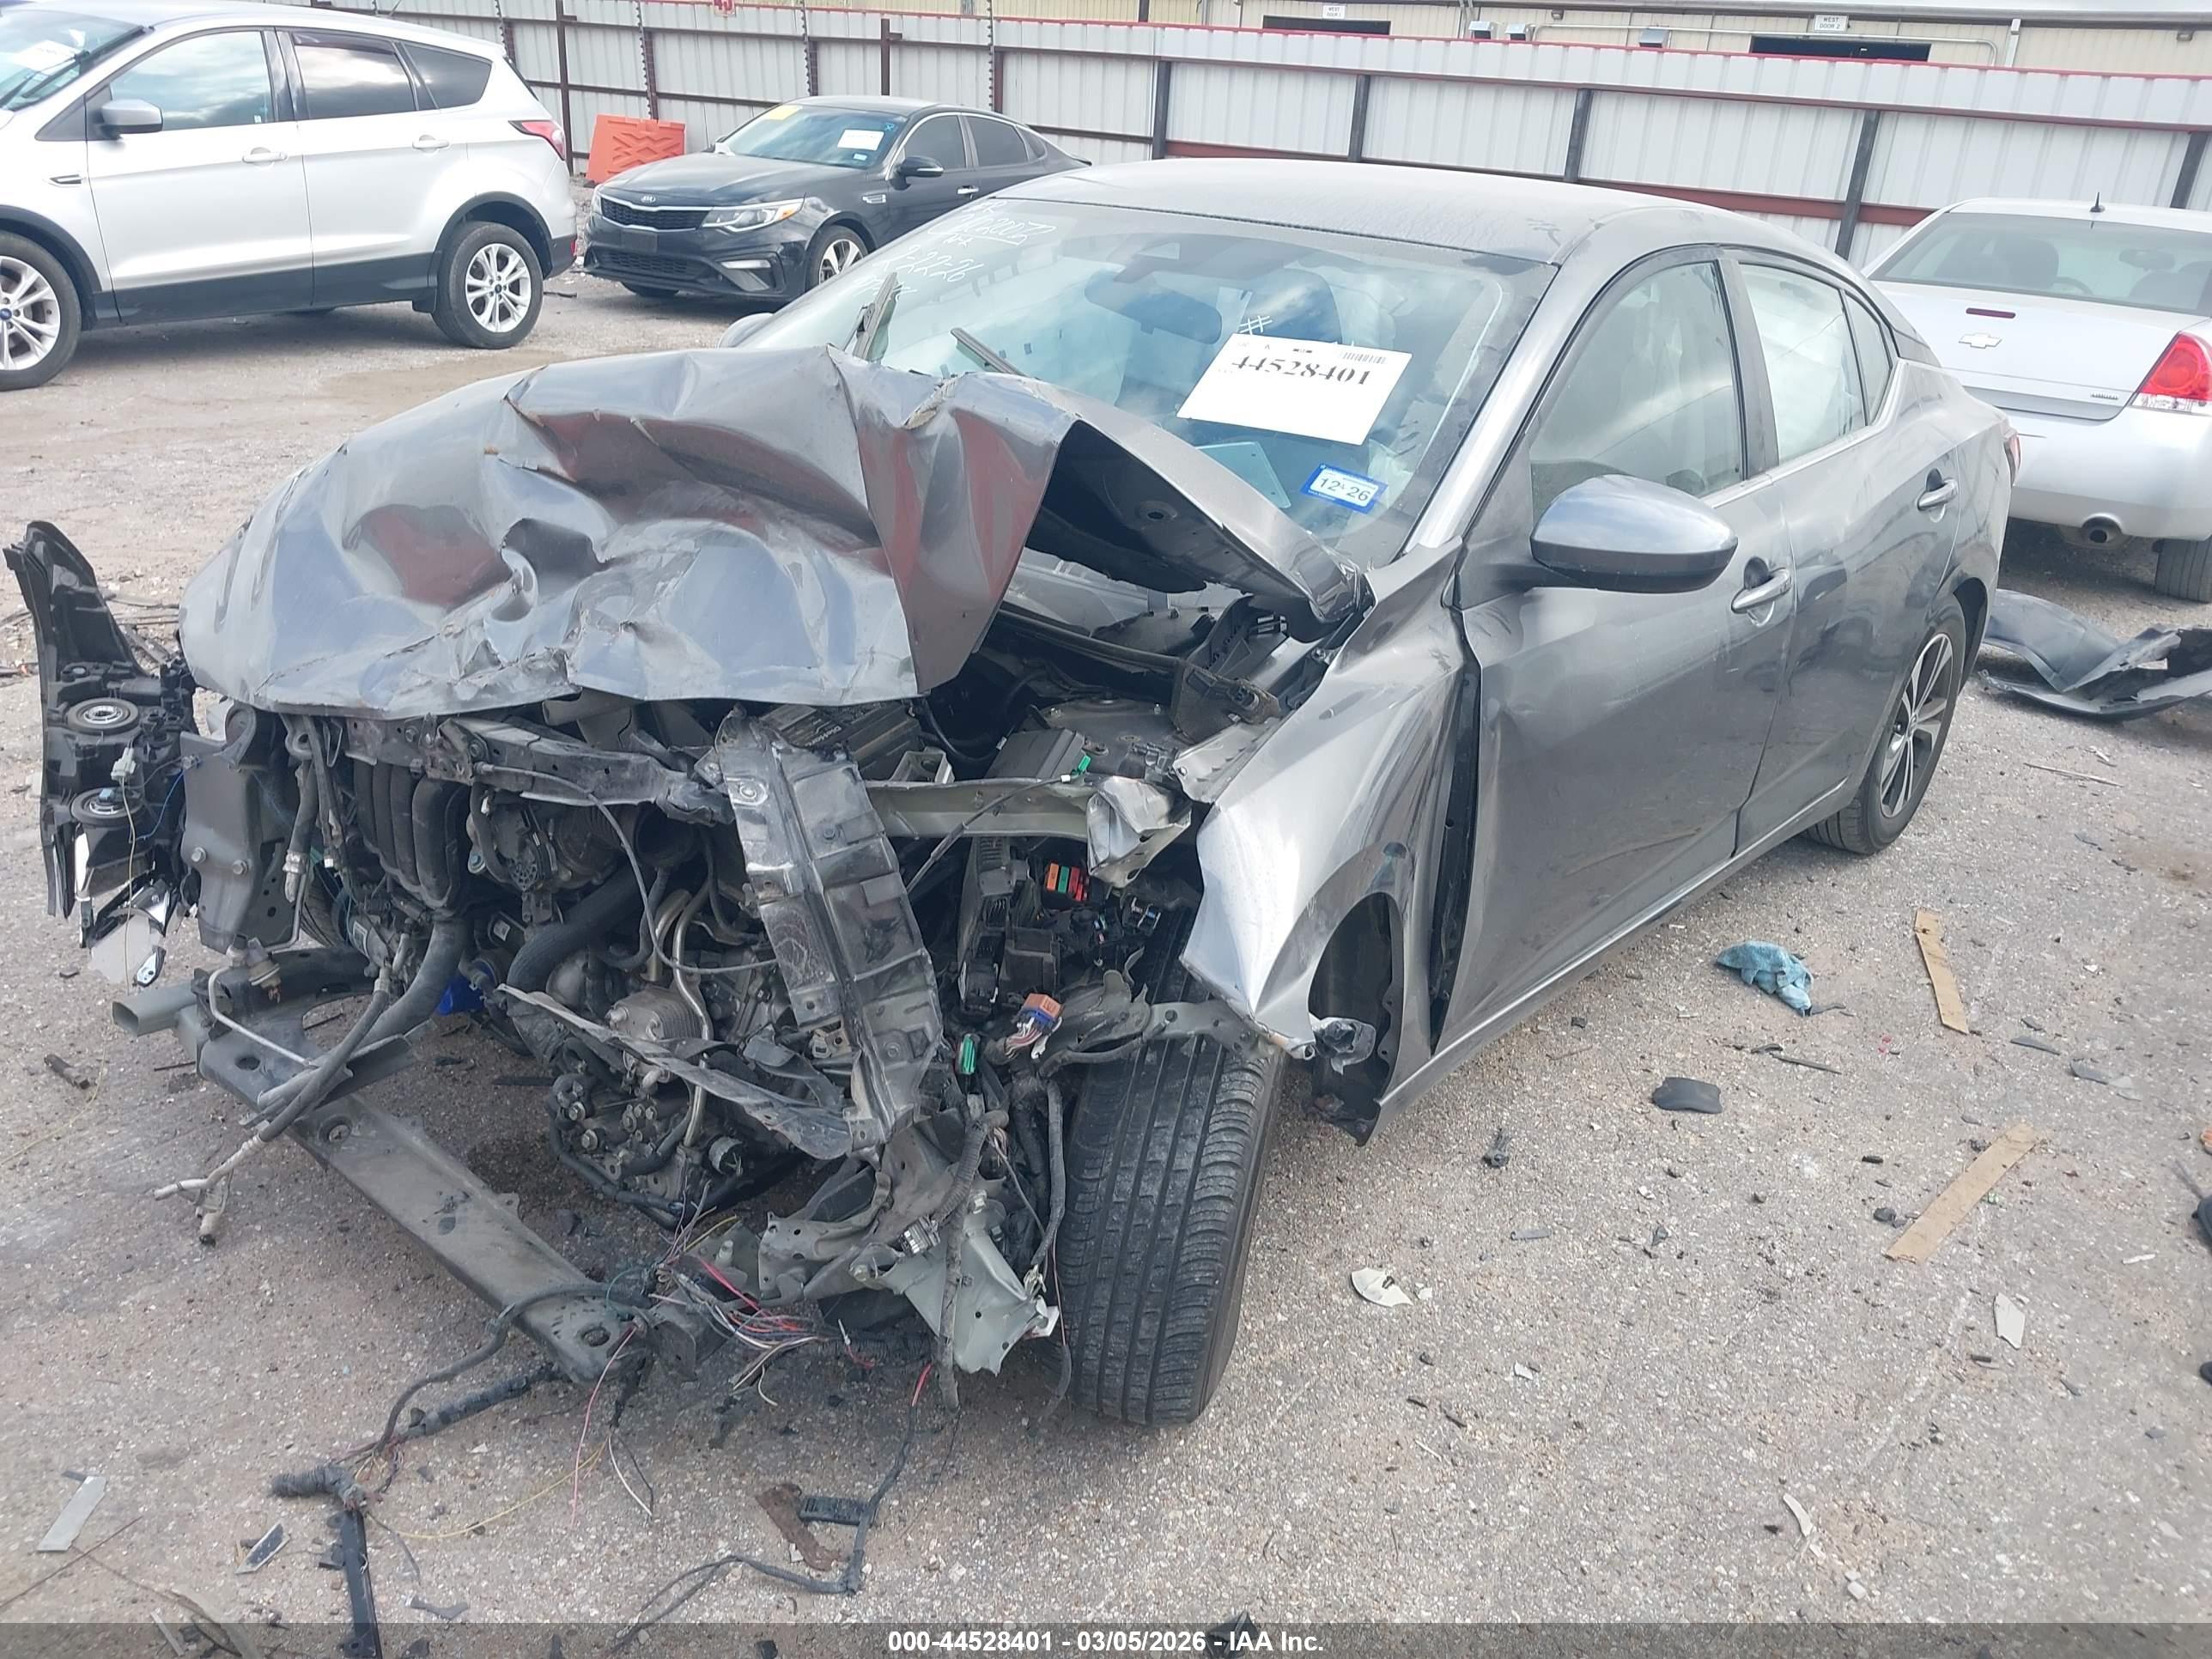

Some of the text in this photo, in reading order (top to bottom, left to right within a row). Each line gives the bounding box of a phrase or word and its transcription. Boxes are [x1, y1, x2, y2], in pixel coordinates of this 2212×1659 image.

[1231, 355, 1371, 386] 44528401
[1320, 477, 1340, 492] 12
[1346, 486, 1371, 501] 26
